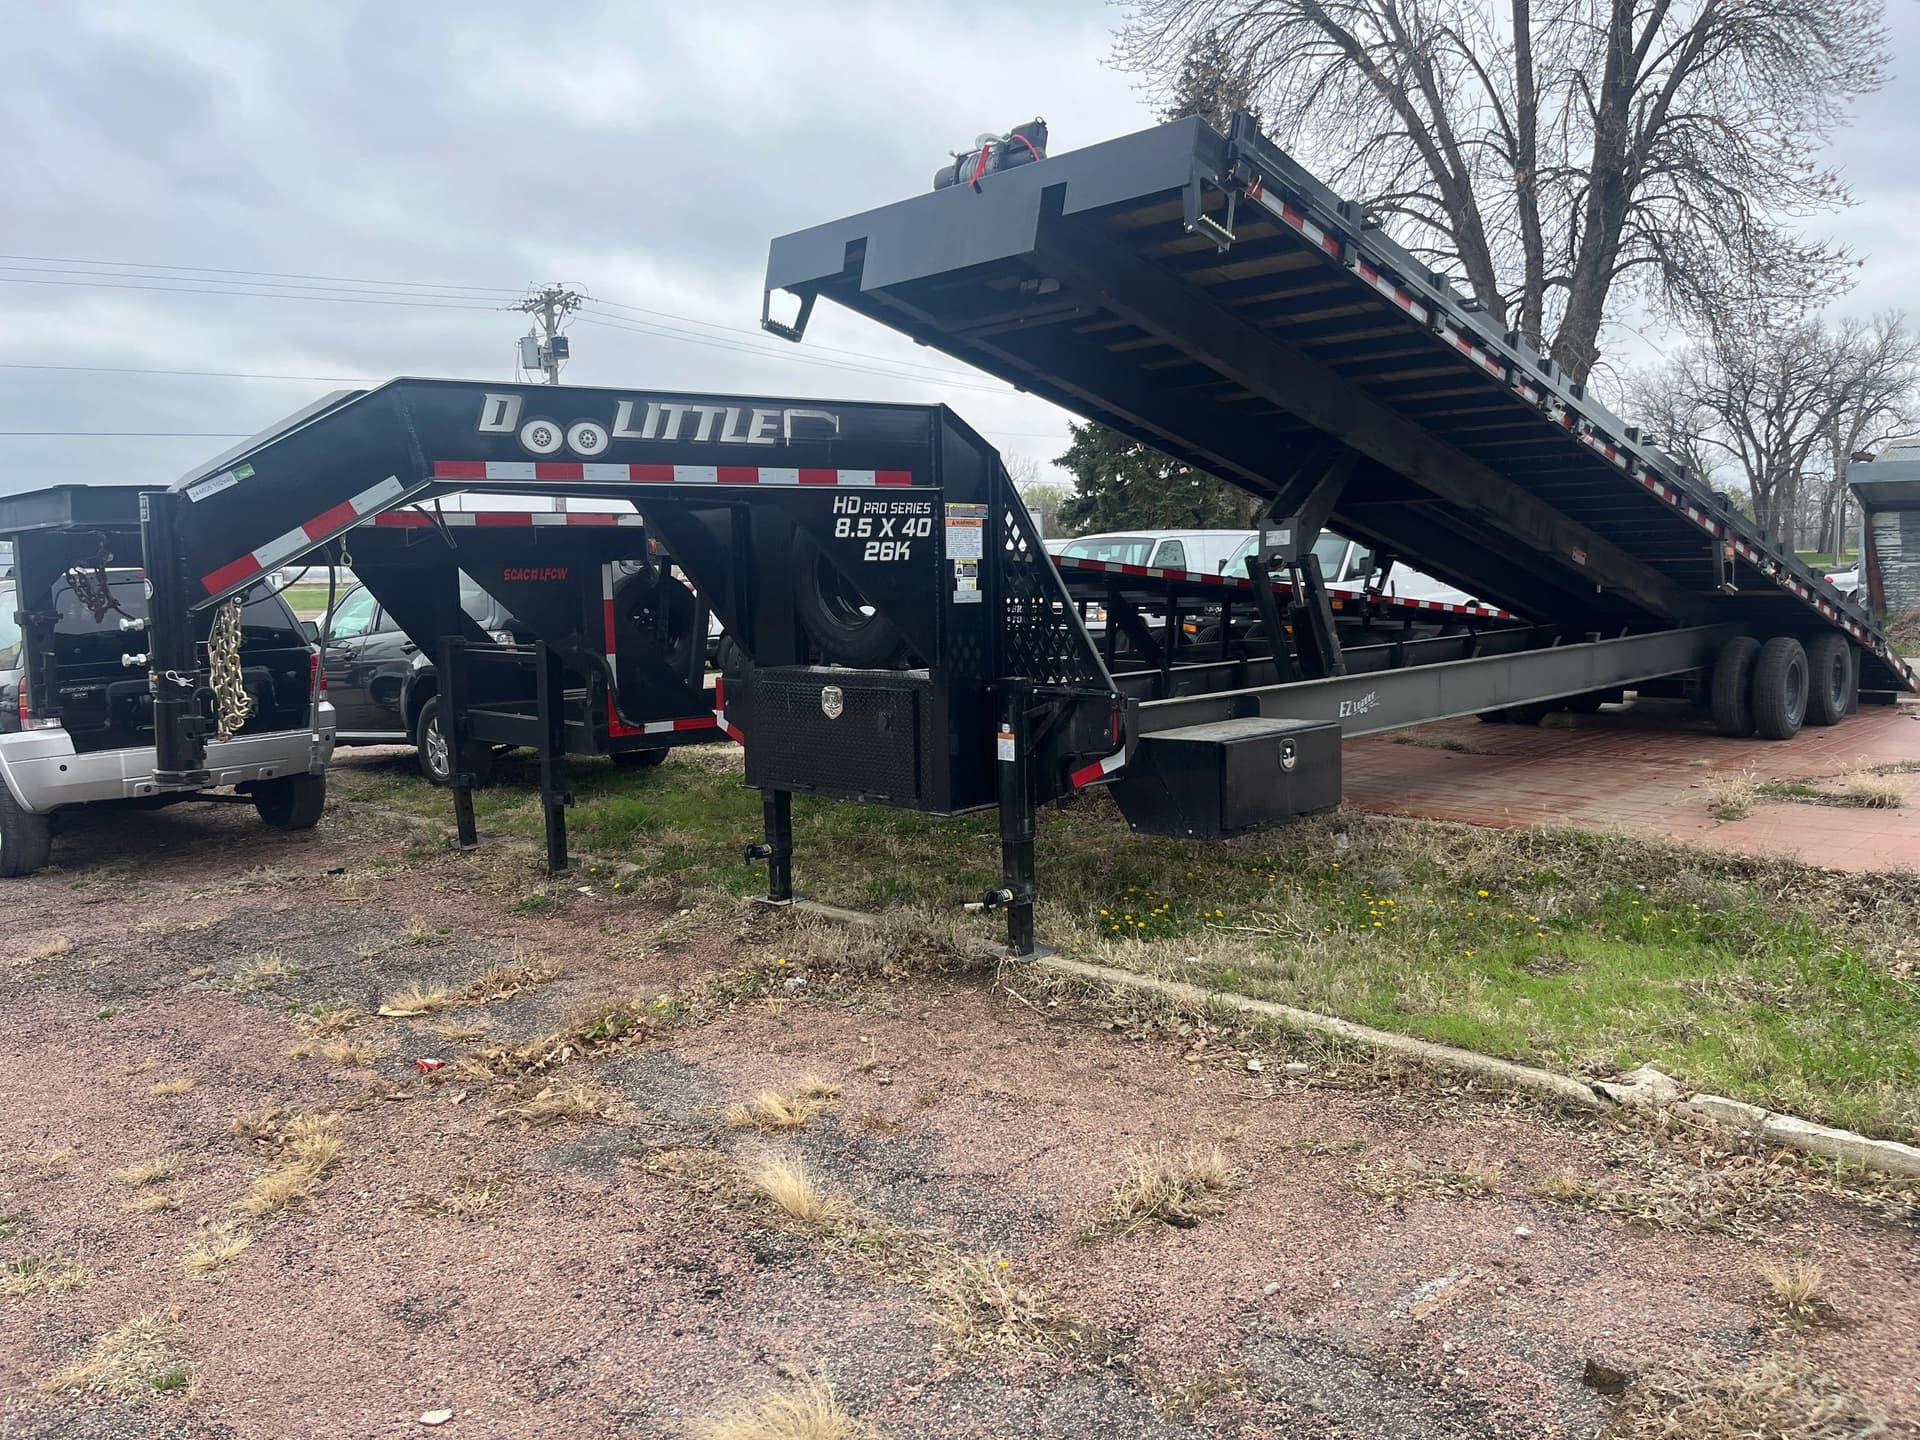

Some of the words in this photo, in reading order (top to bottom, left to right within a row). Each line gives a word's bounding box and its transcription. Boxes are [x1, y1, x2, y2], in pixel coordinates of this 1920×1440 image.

[833, 496, 861, 515] HD
[863, 502, 888, 515] PRO
[890, 502, 931, 515] SERIES
[835, 517, 872, 538] 8.5
[878, 517, 897, 538] X
[901, 517, 932, 538] 40
[864, 541, 911, 561] 26K
[1339, 700, 1353, 718] EZ
